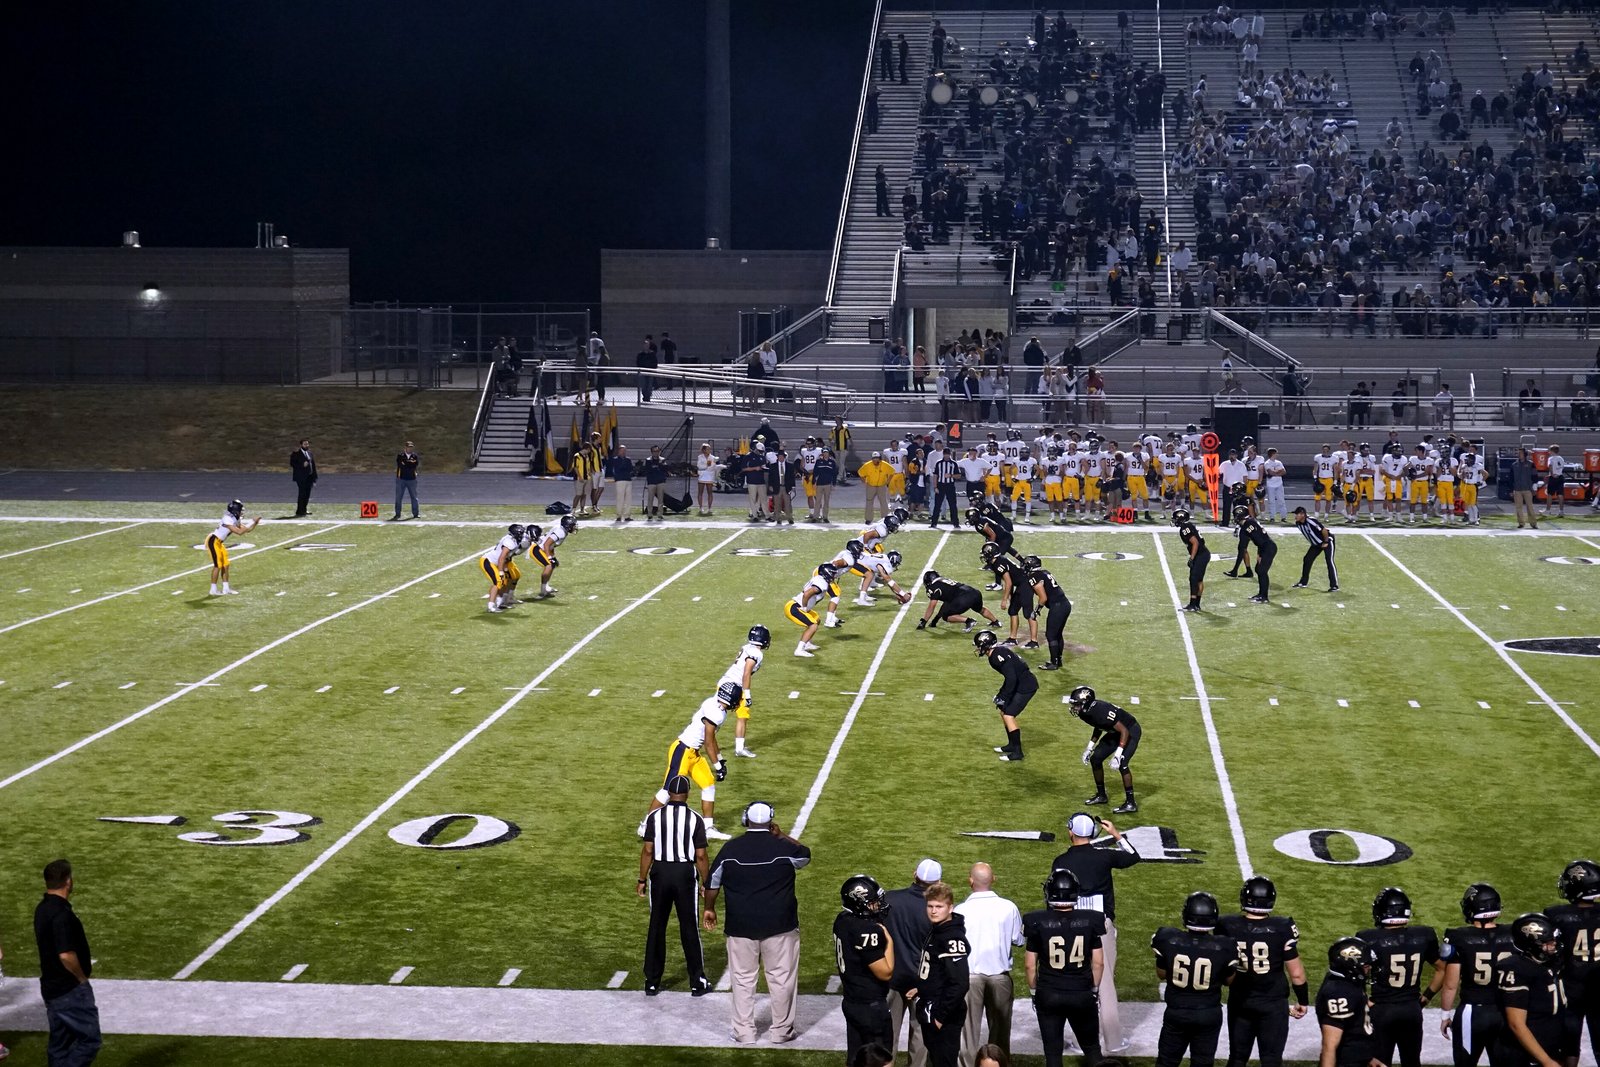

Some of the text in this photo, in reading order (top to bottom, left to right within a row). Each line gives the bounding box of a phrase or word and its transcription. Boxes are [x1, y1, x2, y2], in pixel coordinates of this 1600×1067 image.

[949, 423, 961, 439] 4
[1006, 447, 1018, 458] 70
[805, 455, 815, 464] 82
[890, 456, 899, 464] 91
[1106, 458, 1115, 467] 92
[1131, 461, 1141, 469] 97
[1018, 465, 1028, 474] 16
[363, 503, 377, 515] 20
[1118, 509, 1132, 521] 40
[997, 654, 1005, 663] 4
[1106, 710, 1117, 721] 10
[861, 933, 879, 947] 78
[948, 940, 967, 953] 36
[1048, 935, 1085, 970] 64
[1236, 941, 1271, 975] 58
[1172, 953, 1212, 991] 60
[1388, 953, 1421, 988] 51
[1497, 970, 1516, 985] 74
[1327, 997, 1349, 1014] 62
